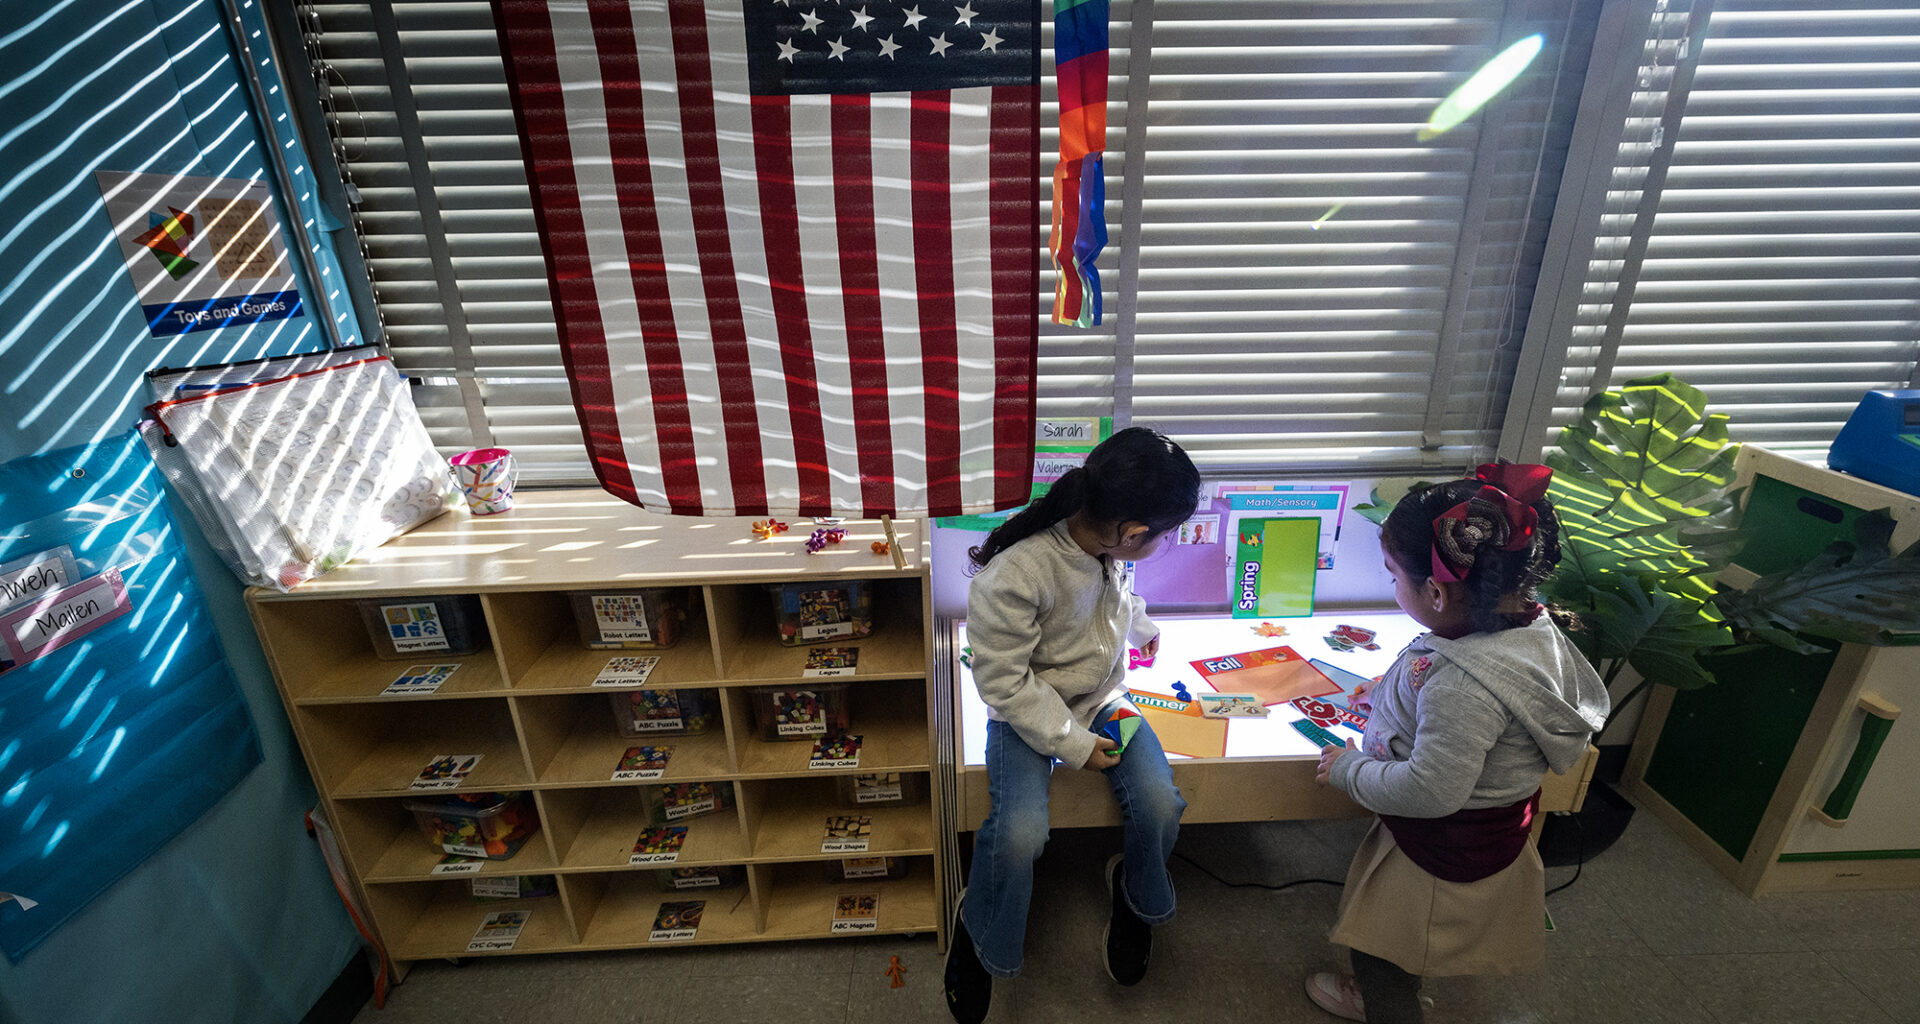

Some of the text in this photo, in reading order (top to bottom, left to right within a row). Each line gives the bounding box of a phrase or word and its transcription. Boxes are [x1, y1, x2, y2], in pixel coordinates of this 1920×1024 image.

[174, 301, 286, 325] Toys and Games
[1043, 422, 1083, 437] Sarah
[1246, 498, 1317, 508] Math/Sensory
[1238, 561, 1260, 610] Spring
[36, 600, 99, 636] Mailen
[397, 641, 422, 649] Magnet
[1203, 655, 1244, 673] Fall
[1130, 693, 1189, 711] mmer
[668, 802, 712, 817] Wood Cubes
[849, 922, 875, 930] Magnets
